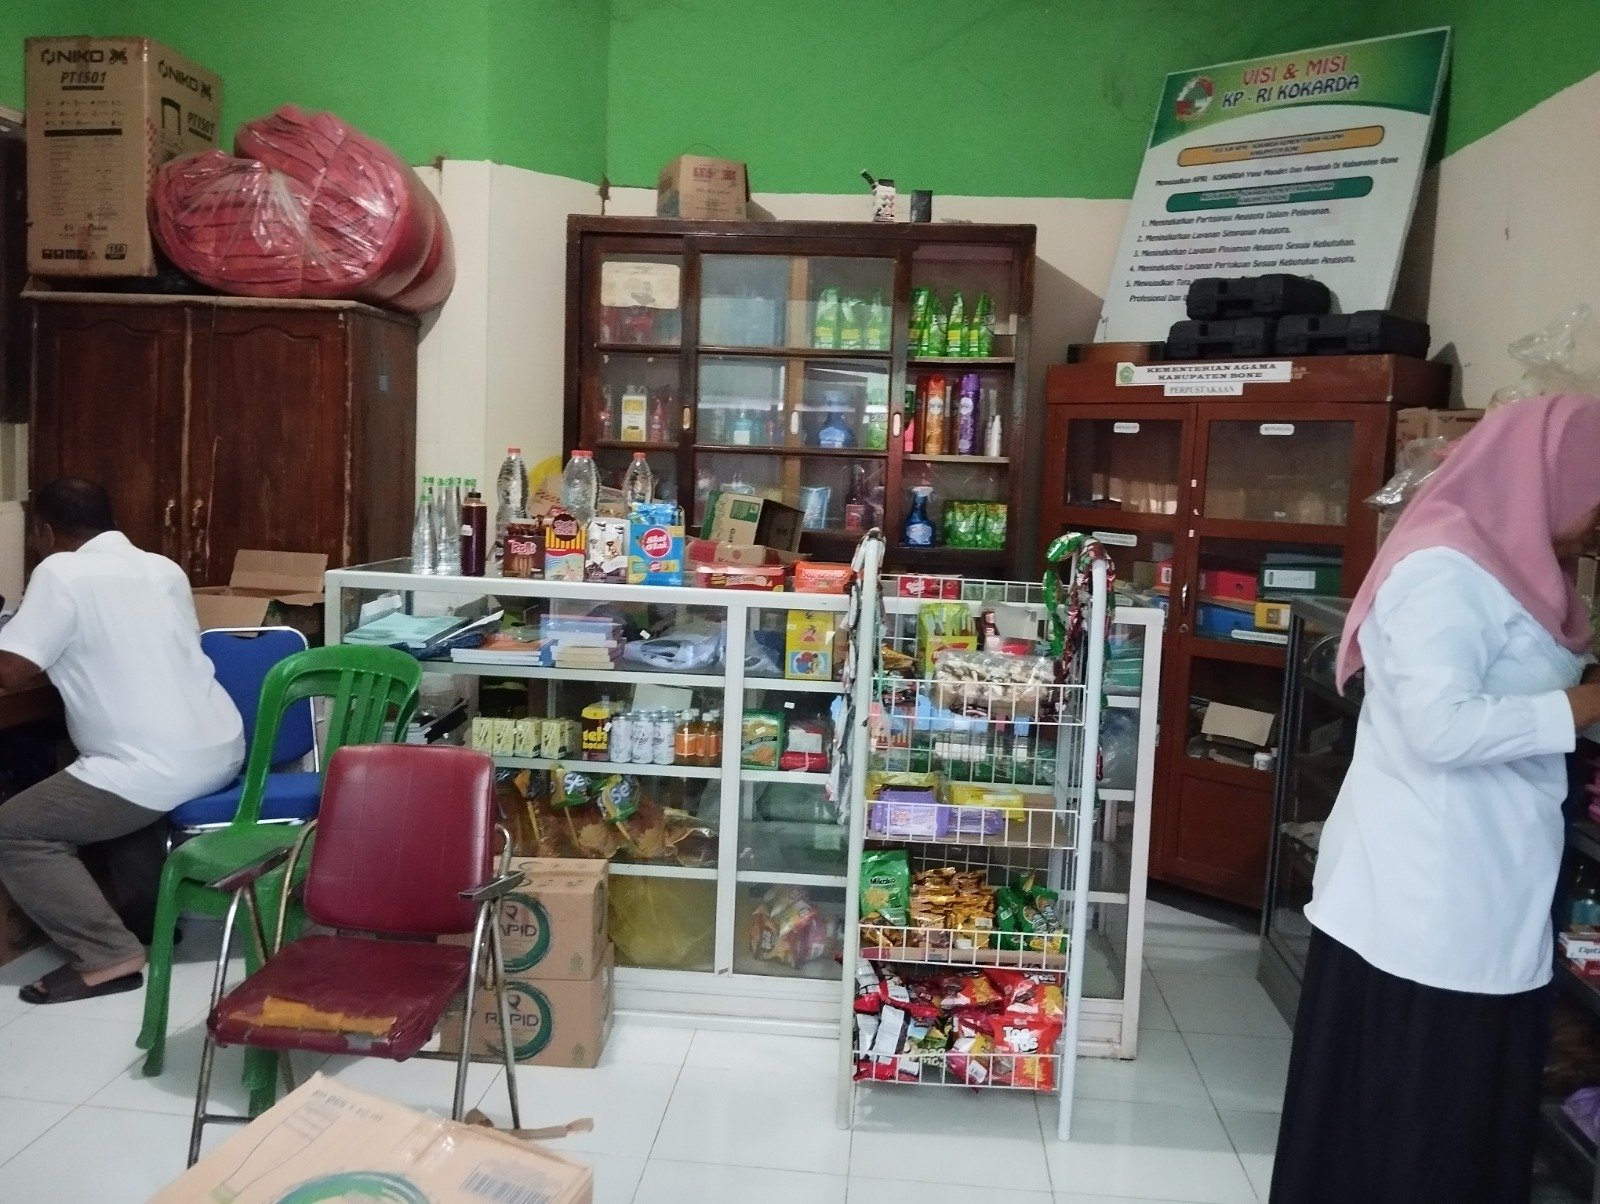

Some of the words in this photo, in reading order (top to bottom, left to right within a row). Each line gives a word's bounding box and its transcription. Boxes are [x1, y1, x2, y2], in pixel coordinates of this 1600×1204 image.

[1243, 66, 1278, 86] VISI
[1283, 63, 1300, 80] &
[1306, 55, 1349, 77] MISI
[1222, 91, 1244, 107] KP
[1256, 87, 1273, 103] RI
[1277, 75, 1359, 101] KOKARDA
[1146, 365, 1232, 374] KEMENTERIAN
[1234, 363, 1277, 371] AGAMA
[1158, 373, 1229, 381] KABUPATEN
[1169, 385, 1235, 394] PERPUSTAKAAN
[485, 1012, 539, 1026] RPID
